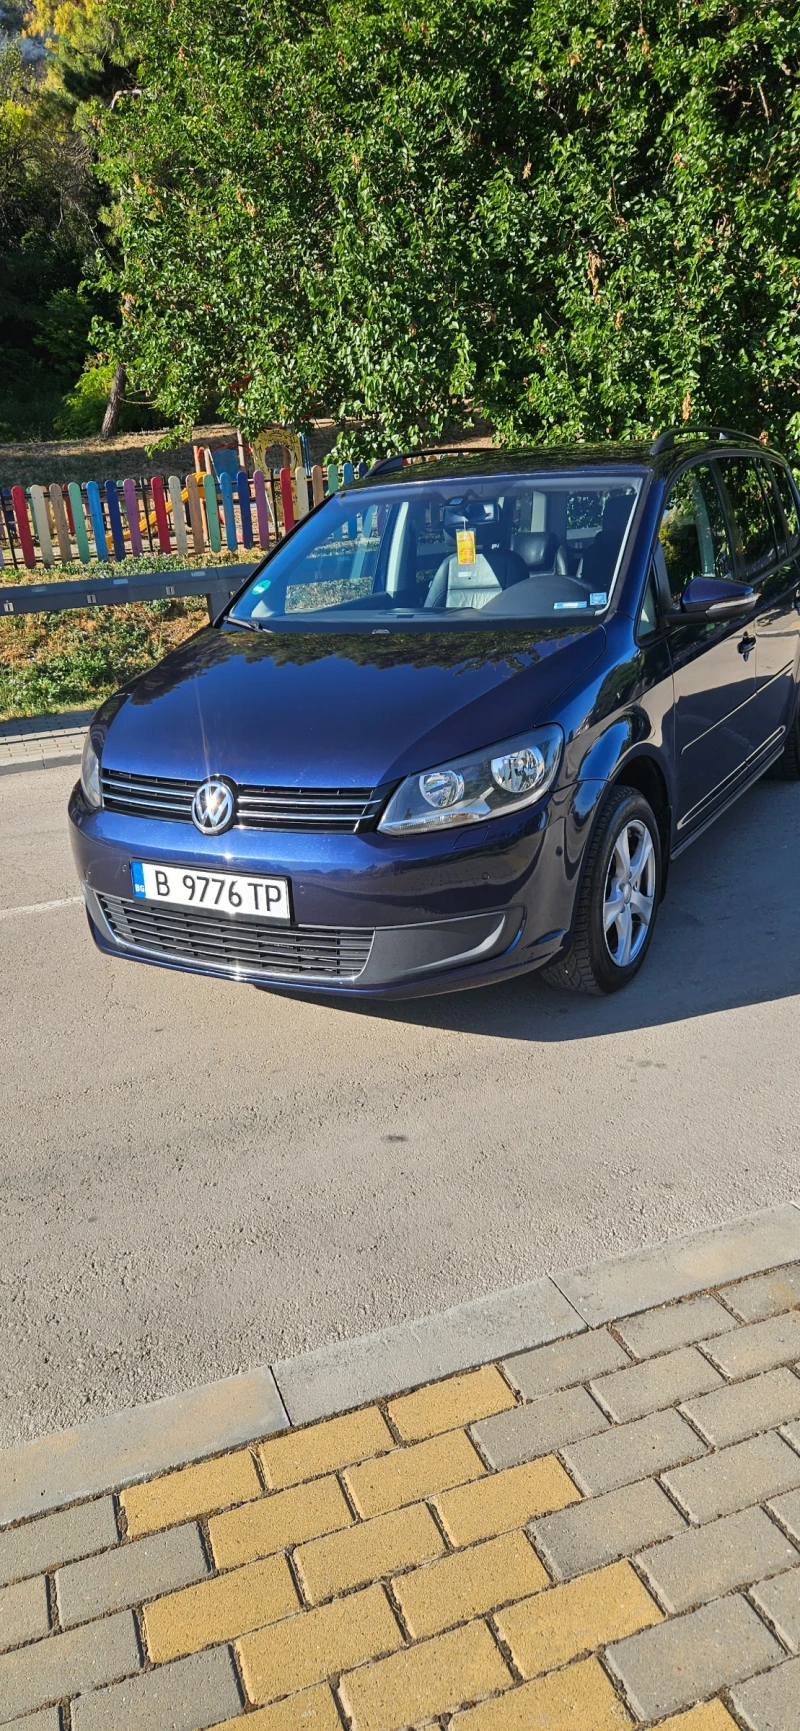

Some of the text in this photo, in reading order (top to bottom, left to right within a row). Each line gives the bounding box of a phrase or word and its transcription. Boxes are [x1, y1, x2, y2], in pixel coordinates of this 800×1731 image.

[192, 782, 232, 832] VW
[135, 883, 145, 893] BG
[155, 870, 282, 911] B 9776 TP
